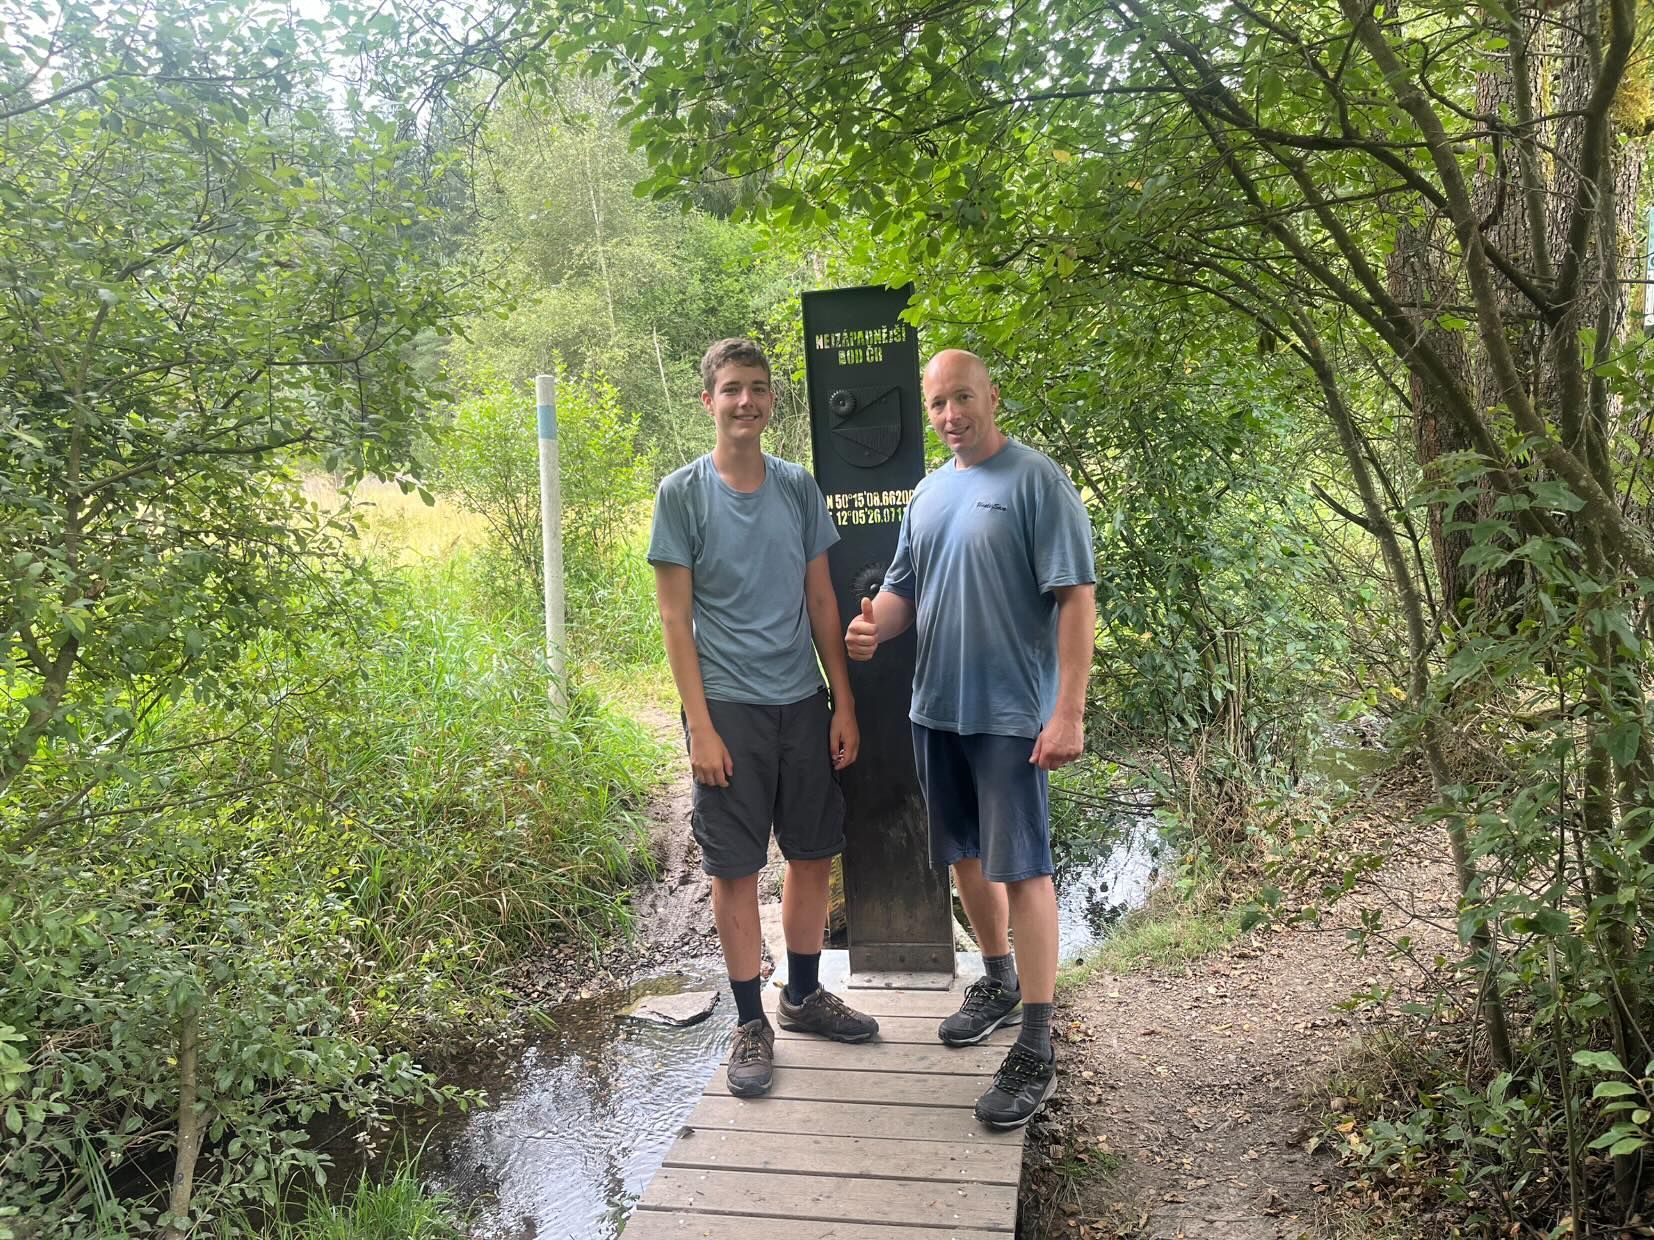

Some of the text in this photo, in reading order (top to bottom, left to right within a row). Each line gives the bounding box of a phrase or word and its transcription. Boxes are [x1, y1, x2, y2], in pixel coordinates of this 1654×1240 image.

[838, 348, 863, 365] BOD
[826, 494, 834, 509] N
[836, 507, 907, 526] 12°05'26.071
